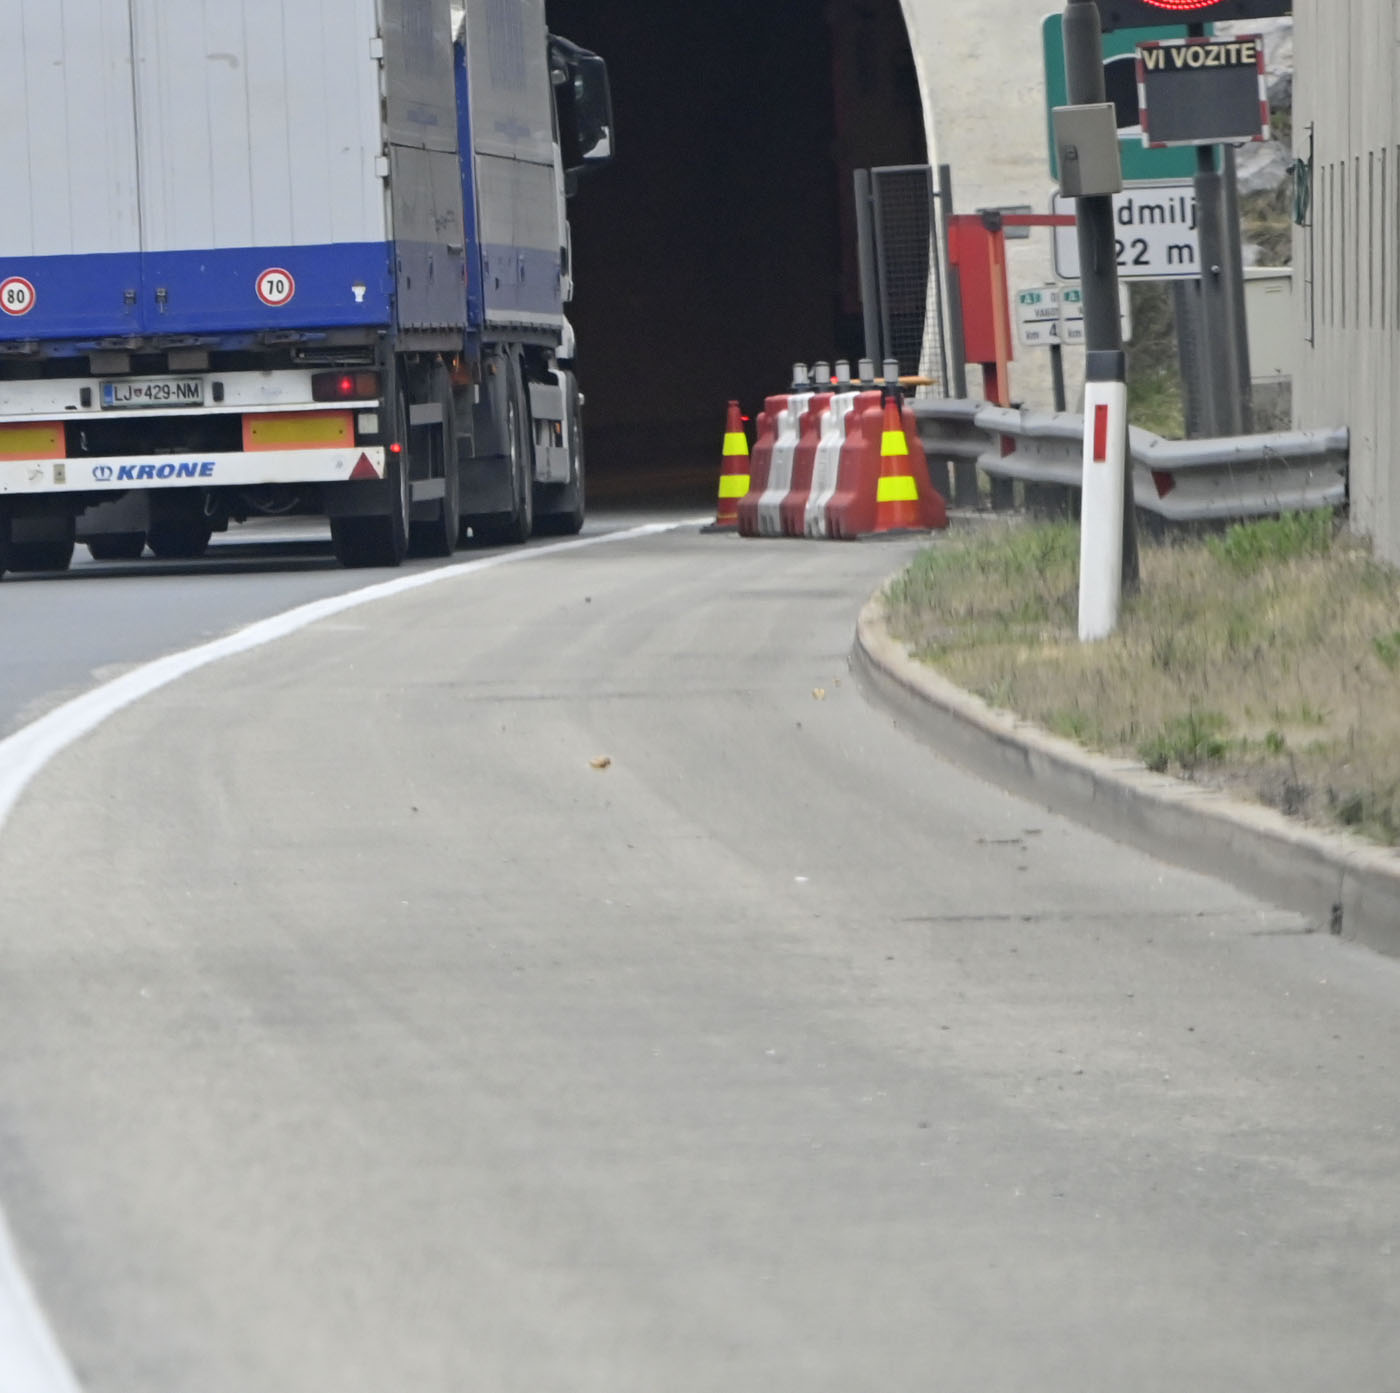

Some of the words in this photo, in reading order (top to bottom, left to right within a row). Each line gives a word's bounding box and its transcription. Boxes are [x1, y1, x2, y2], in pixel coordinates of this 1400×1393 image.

[1142, 48, 1166, 70] VI
[1171, 42, 1257, 68] VOZITE
[1118, 196, 1198, 230] dmilj
[1115, 238, 1150, 266] 22
[1167, 243, 1194, 265] m
[7, 289, 25, 304] 80
[266, 279, 285, 295] 70
[114, 386, 132, 402] LJ
[144, 383, 200, 400] 429-NM
[117, 461, 216, 481] KRONE
